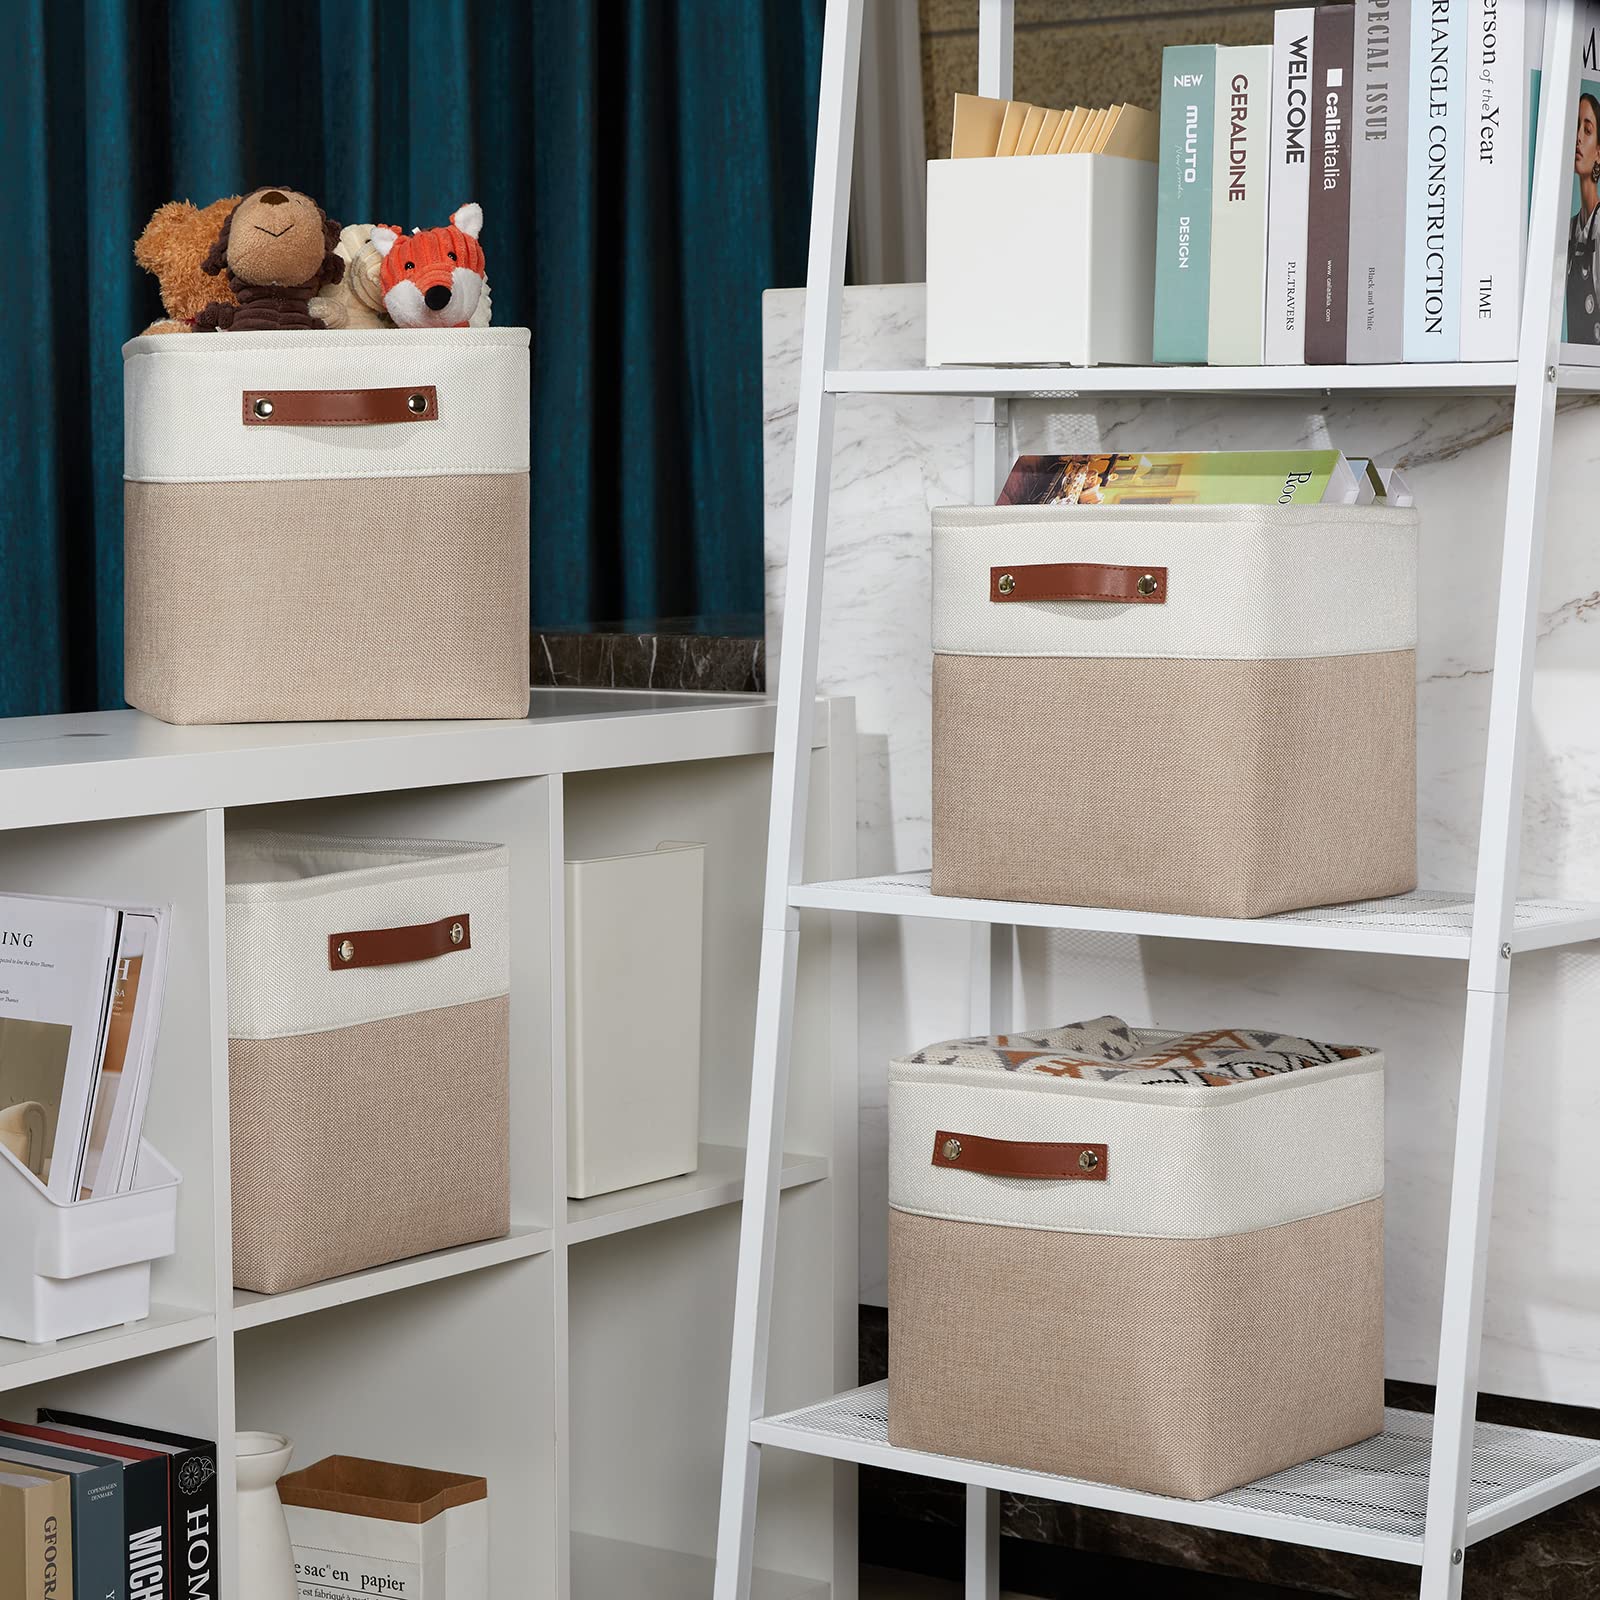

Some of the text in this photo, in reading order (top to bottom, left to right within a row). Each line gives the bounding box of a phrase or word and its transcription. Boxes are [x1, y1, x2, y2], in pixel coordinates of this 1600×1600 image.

[1173, 74, 1203, 88] NEW
[1285, 35, 1309, 164] WELCOME
[1479, 68, 1494, 84] of
[1481, 88, 1493, 111] the
[1228, 74, 1249, 202] GERALDINE
[1365, 82, 1388, 141] ISSUE
[1479, 107, 1500, 165] Year
[1323, 92, 1341, 190] caliaitalia
[1178, 216, 1190, 269] DESIGN
[1424, 125, 1448, 335] CONSTRUCTION
[1366, 266, 1376, 332] Black and White
[1478, 275, 1493, 320] TIME
[2, 931, 34, 948] ING
[332, 1569, 349, 1582] en
[360, 1574, 405, 1593] papier
